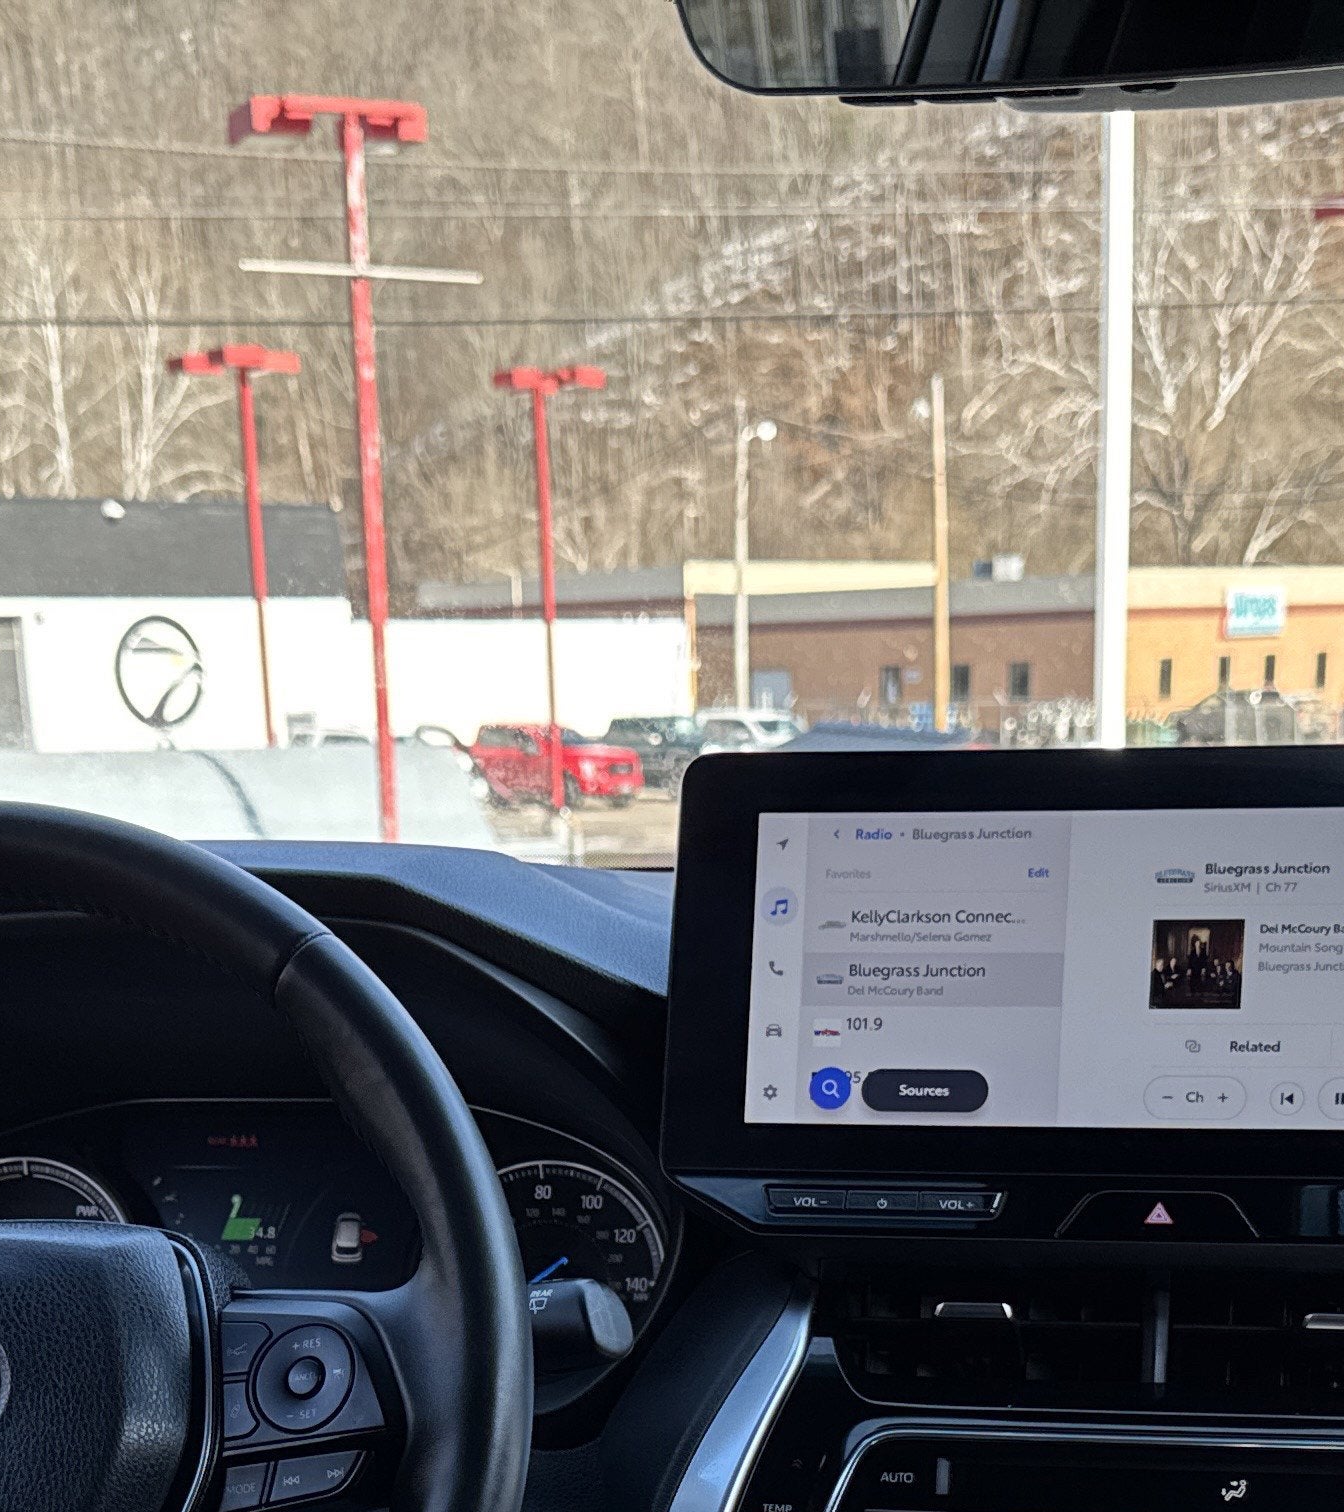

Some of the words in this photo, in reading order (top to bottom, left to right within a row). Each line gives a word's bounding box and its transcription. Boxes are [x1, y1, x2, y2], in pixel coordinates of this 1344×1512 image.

[856, 828, 893, 841] Radio
[912, 828, 975, 843] Bluegrass
[976, 827, 1033, 841] Junction
[825, 868, 872, 880] Favorites
[1027, 867, 1050, 879] Edit
[1205, 863, 1270, 878] Bluegrass
[1272, 862, 1331, 875] Junction
[1203, 882, 1251, 894] SiriusXM
[1265, 882, 1281, 893] Ch
[1283, 882, 1298, 893] 77
[851, 909, 951, 927] KellyClarkson
[1259, 923, 1279, 935] Del
[1281, 923, 1331, 936] McCoury
[850, 931, 951, 944] Marshmello/Selena
[953, 932, 993, 943] Gomez
[1258, 942, 1311, 954] Mountain
[1314, 942, 1344, 955] Song
[848, 964, 920, 981] Bluegrass
[923, 963, 986, 978] Junction
[1257, 961, 1311, 975] Bluegrass
[847, 985, 864, 996] Del
[867, 985, 915, 998] McCoury
[916, 985, 944, 997] Band
[845, 1017, 884, 1032] 101.9
[1229, 1040, 1282, 1054] Related
[898, 1084, 951, 1098] Sources
[1184, 1091, 1204, 1104] Ch
[533, 1184, 552, 1200] 80
[579, 1194, 603, 1210] 100
[75, 1204, 100, 1218] PWR
[613, 1228, 637, 1244] 120
[624, 1276, 649, 1292] 140
[302, 1337, 322, 1349] RES
[299, 1409, 317, 1420] SET
[880, 1471, 914, 1484] AUTO
[225, 1482, 257, 1496] MODE
